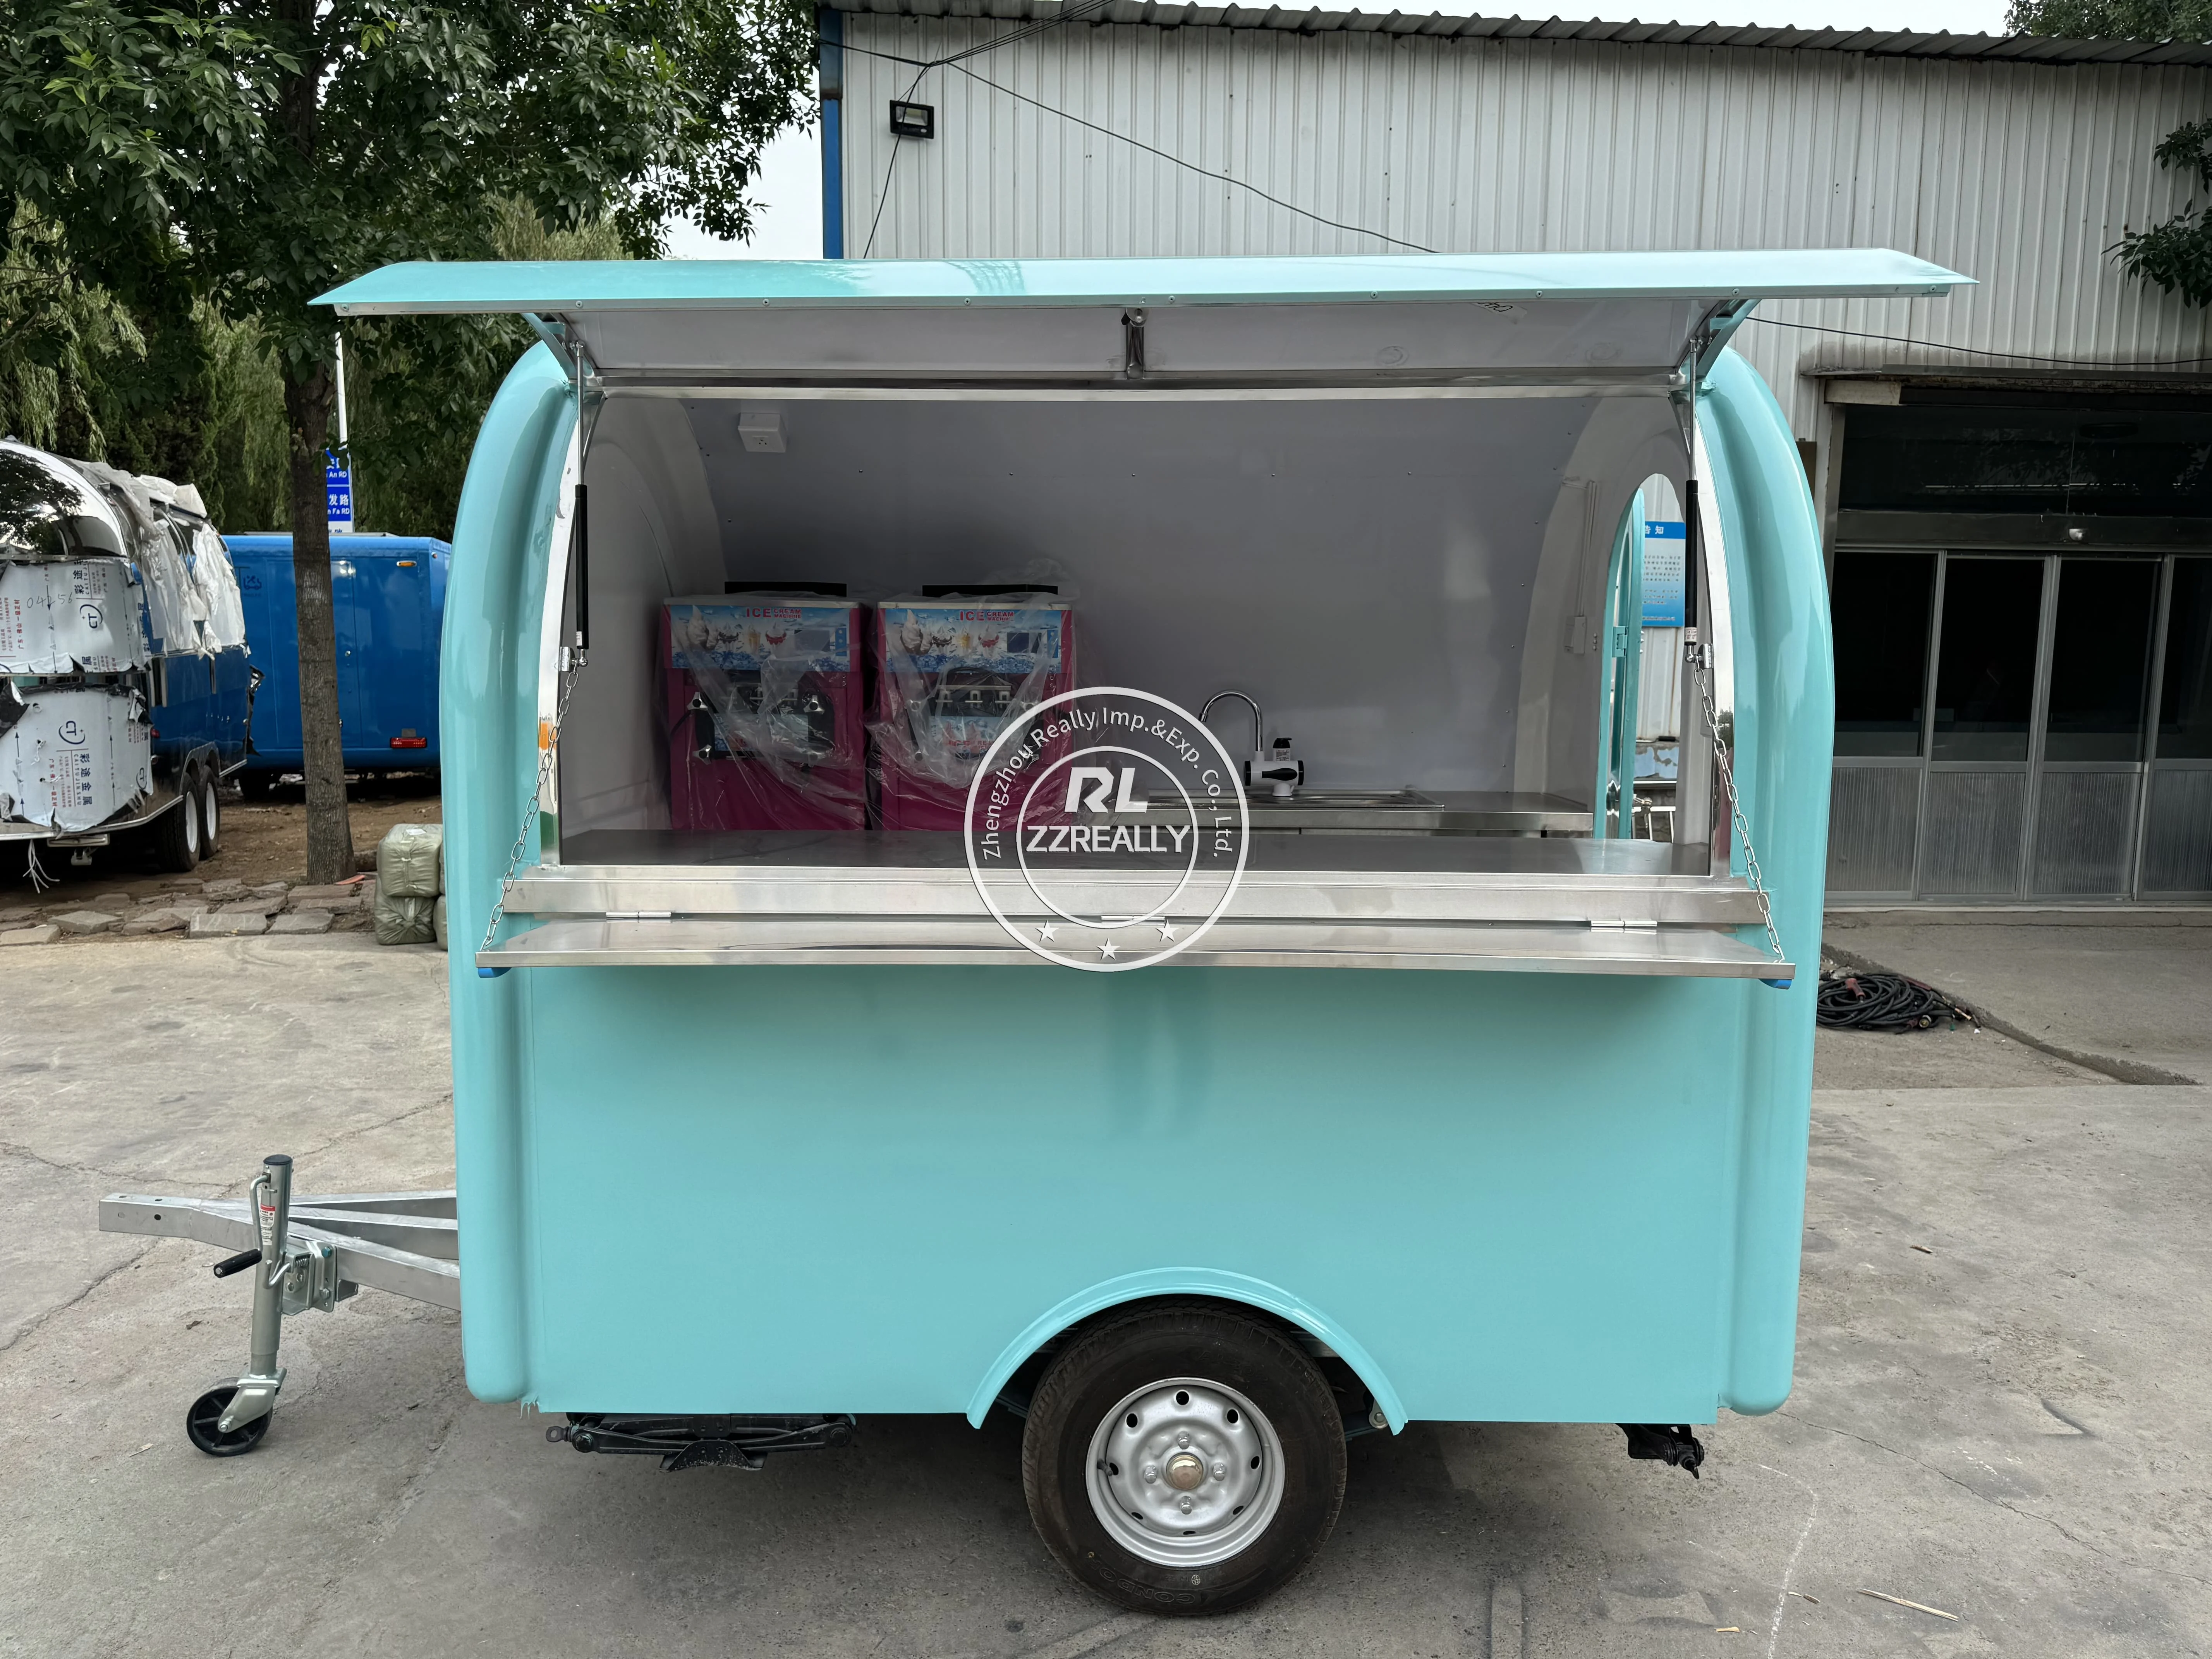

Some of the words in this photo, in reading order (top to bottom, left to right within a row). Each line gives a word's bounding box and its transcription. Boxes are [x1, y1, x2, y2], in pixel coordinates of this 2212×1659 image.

[329, 493, 349, 506] 发路
[746, 608, 771, 618] ICE
[960, 611, 984, 621] ICE
[88, 613, 98, 629] CT
[66, 720, 77, 736] CT
[80, 753, 93, 806] 彩途金属
